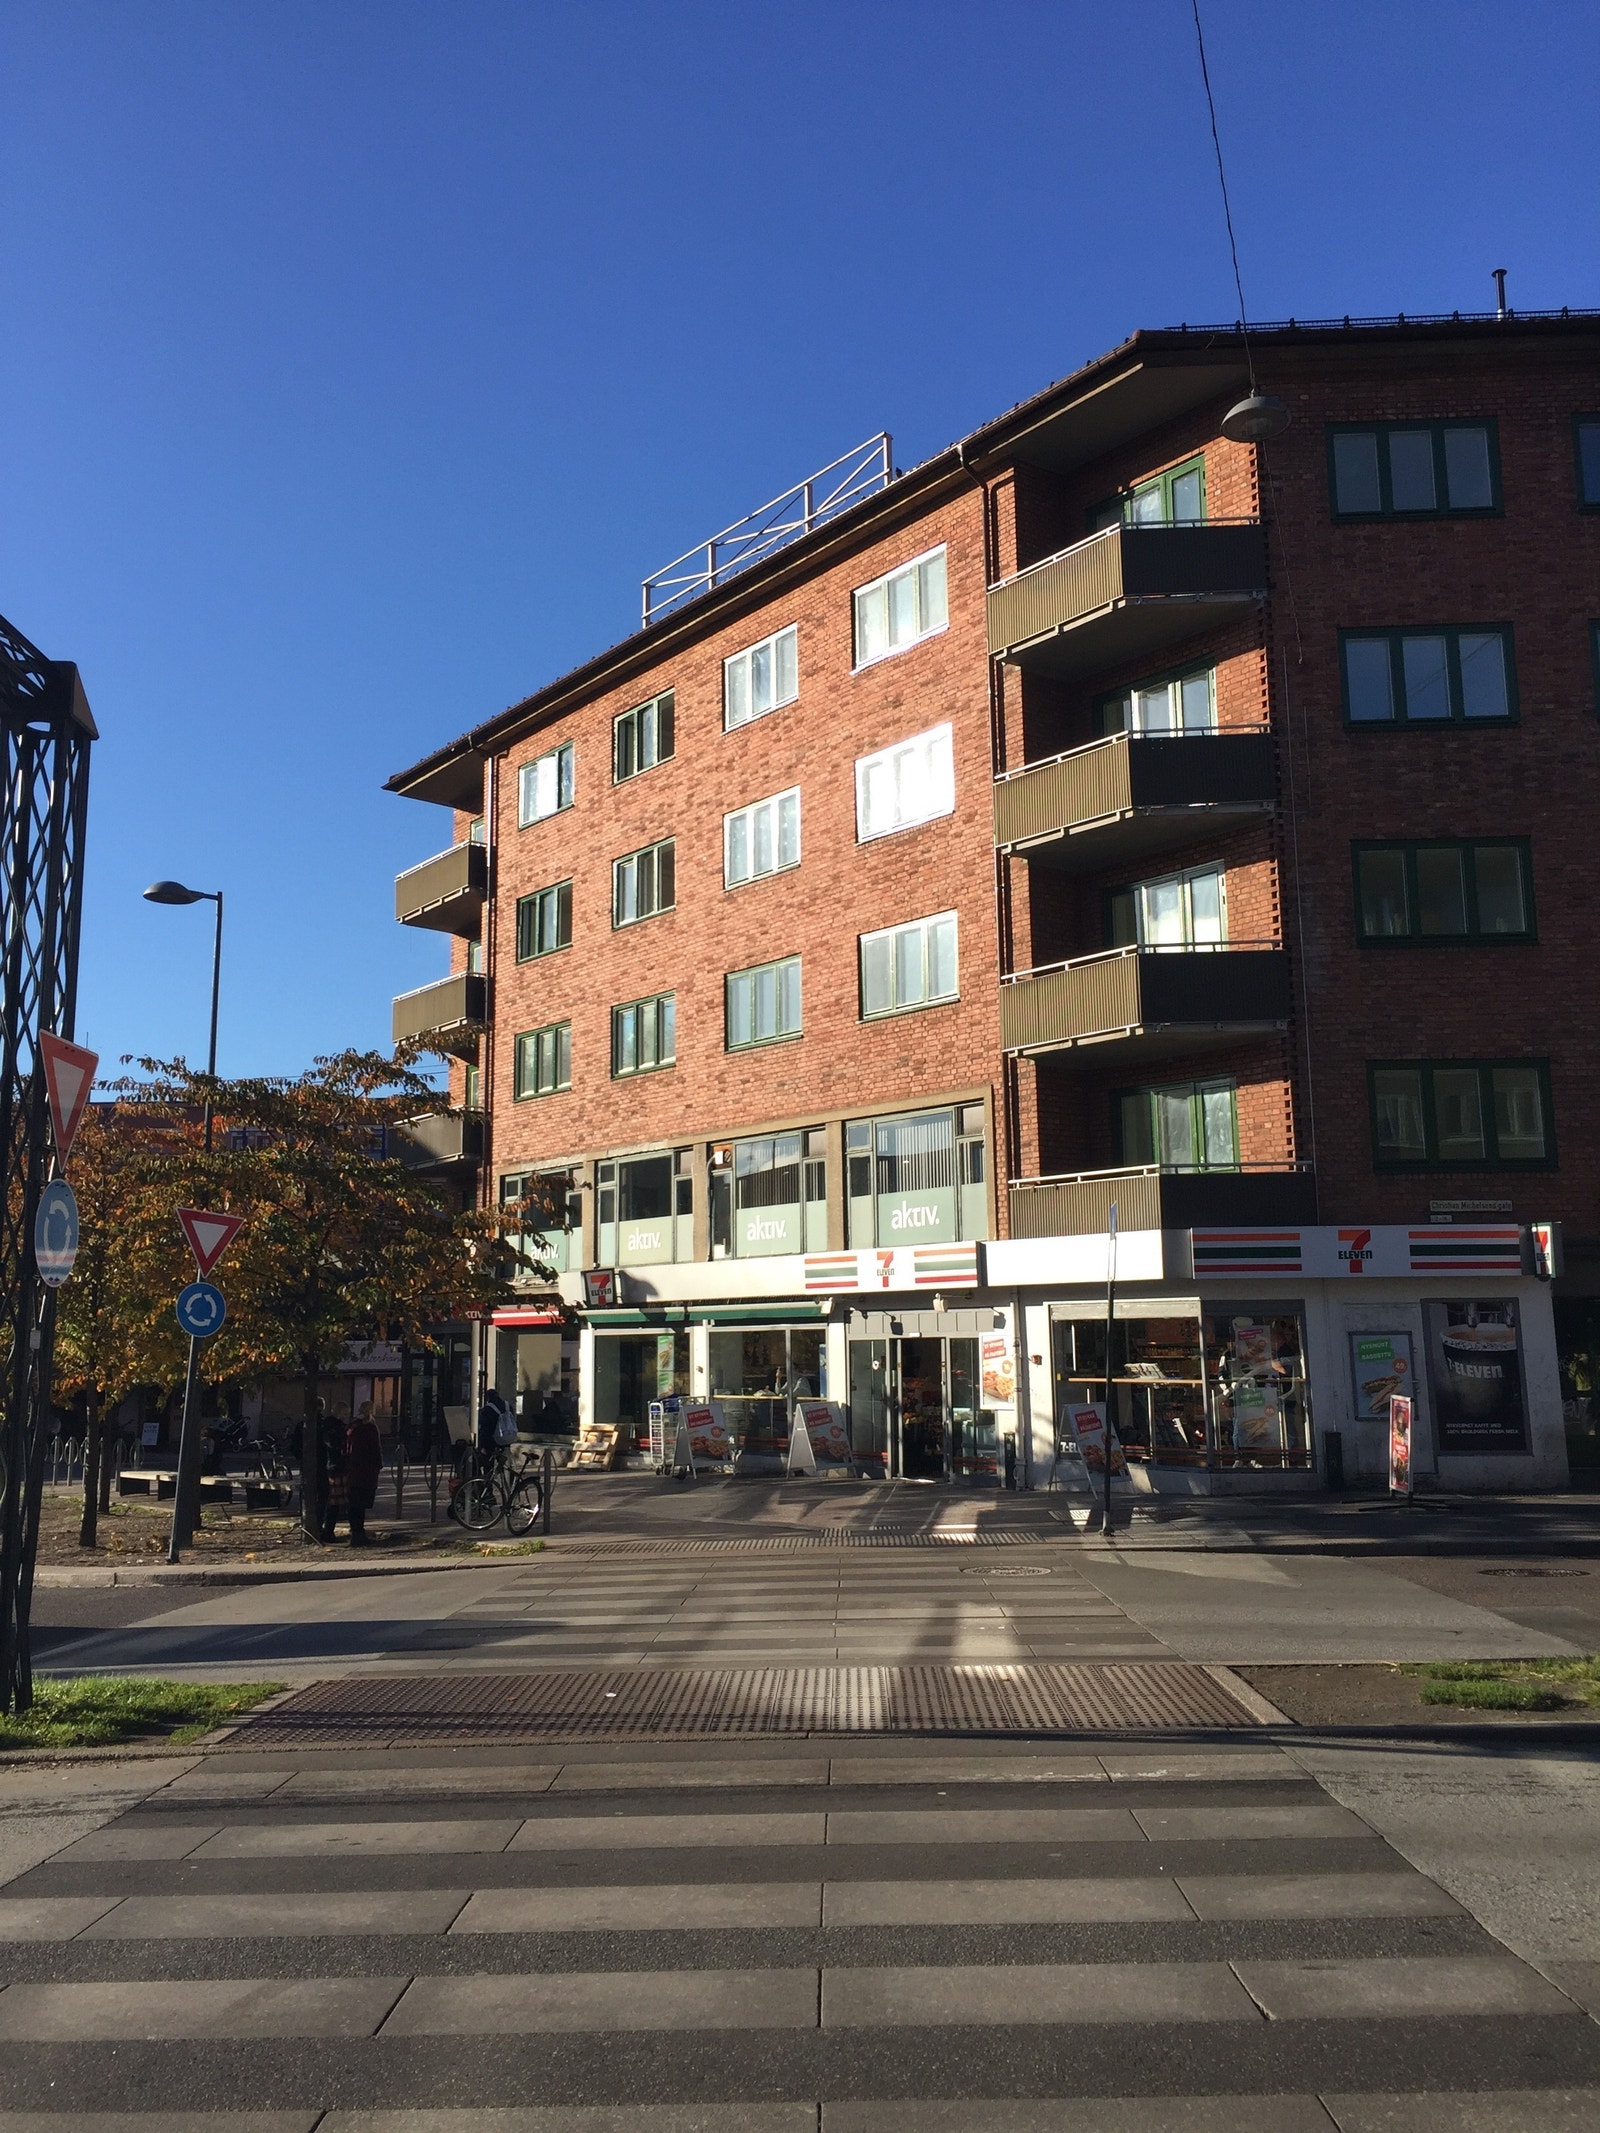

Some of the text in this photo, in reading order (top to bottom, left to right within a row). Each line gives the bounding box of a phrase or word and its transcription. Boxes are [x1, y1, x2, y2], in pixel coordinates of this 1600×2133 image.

[877, 1251, 894, 1287] 7
[1338, 1229, 1371, 1273] 7
[591, 1274, 610, 1305] 7
